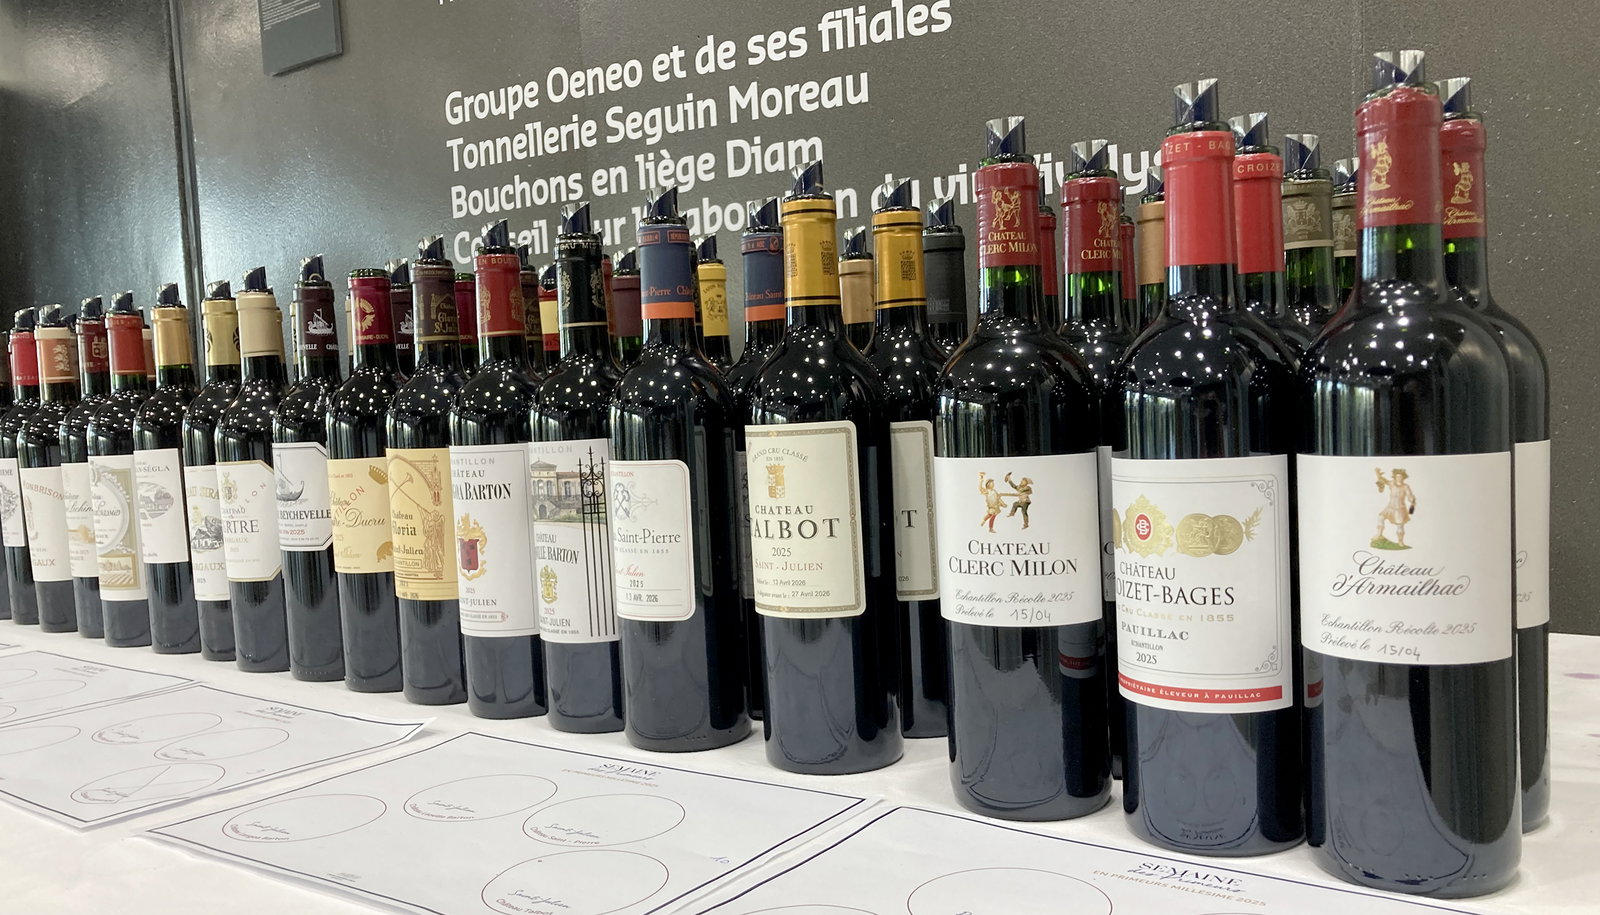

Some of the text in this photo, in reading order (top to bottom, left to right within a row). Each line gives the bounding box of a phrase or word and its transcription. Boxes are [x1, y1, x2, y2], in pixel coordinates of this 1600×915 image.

[445, 0, 952, 125] Groupe Oeneo et de ses filiales
[446, 71, 869, 172] Tonnellerie Seguin Moreau
[451, 171, 584, 219] Bouchons
[591, 164, 628, 197] en
[634, 149, 716, 193] liège
[726, 136, 823, 178] Diam
[454, 219, 549, 265] Coseil
[1081, 249, 1111, 260] CLERC
[465, 481, 512, 501] BARTON
[755, 504, 814, 515] CHATEAU
[223, 519, 260, 534] RTRE
[617, 527, 681, 544] Saint-Pierre
[547, 547, 579, 564] BARTON
[772, 547, 792, 557] 2025
[968, 540, 1051, 556] CHATEAU
[949, 556, 1078, 577] CLERC MILON
[1120, 561, 1176, 580] CHÂTEAU
[1352, 550, 1446, 576] Château
[1116, 577, 1236, 606] OIZET-BAGES
[1329, 573, 1472, 598] d'Armailhac
[955, 588, 1002, 603] Echantillon
[1048, 591, 1075, 603] 2025
[1009, 607, 1051, 623] 15/04
[1200, 614, 1235, 622] 1855
[1321, 612, 1478, 636] Echantillon Récolte 2025
[1121, 621, 1190, 641] PAUILLAC
[1136, 651, 1158, 665] 2025
[1377, 645, 1421, 661] 15/04
[1159, 686, 1200, 698] ÉLEVEUR
[1204, 690, 1211, 699] À
[1214, 692, 1262, 700] PAUILLAC
[1138, 862, 1243, 888] SEMAINE
[1093, 869, 1105, 877] EN
[1109, 873, 1170, 890] PRIMEURS
[1234, 897, 1268, 908] 2025
